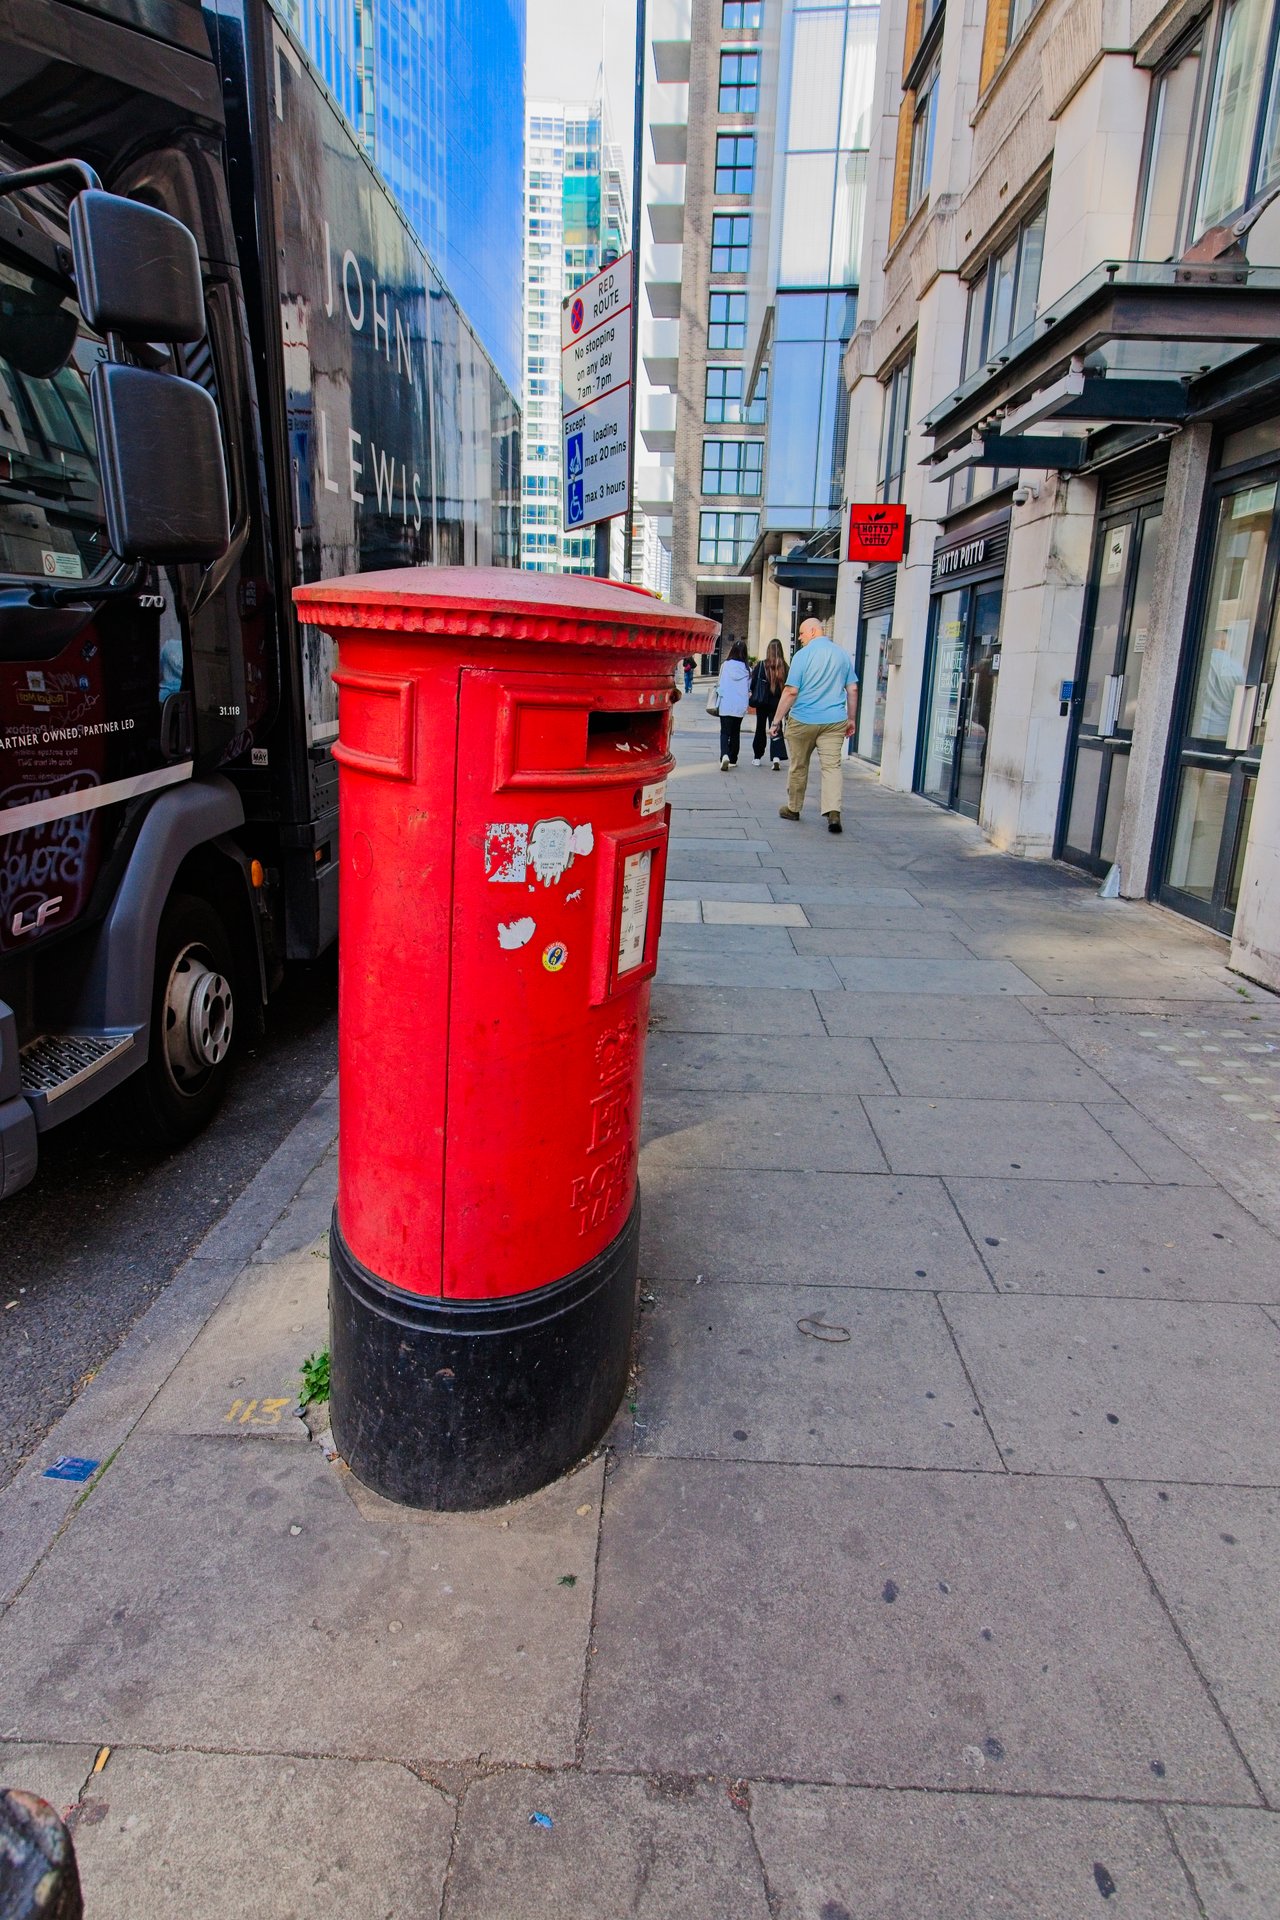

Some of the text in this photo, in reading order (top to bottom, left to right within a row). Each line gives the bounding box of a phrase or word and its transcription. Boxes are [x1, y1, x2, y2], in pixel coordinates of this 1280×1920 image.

[598, 274, 614, 297] RED
[325, 220, 413, 385] JOHN
[593, 289, 619, 318] ROUTE
[575, 327, 615, 361] No stopping
[577, 351, 612, 382] on any day
[565, 414, 586, 435] Except
[592, 422, 618, 442] loading
[584, 440, 627, 467] max 20 mins
[321, 410, 422, 531] LEWIS
[584, 480, 626, 503] max 3 hours
[862, 524, 889, 533] HOTTO
[864, 537, 885, 545] POTTO
[936, 539, 985, 576] HOTTO POTTO
[139, 594, 164, 608] 170
[219, 706, 240, 715] 31.118
[0, 733, 39, 750] ARTNER
[42, 727, 82, 743] OWNED,
[84, 721, 119, 736] PARTNER
[121, 718, 135, 730] LED
[254, 753, 267, 761] MAY
[12, 895, 63, 936] LF
